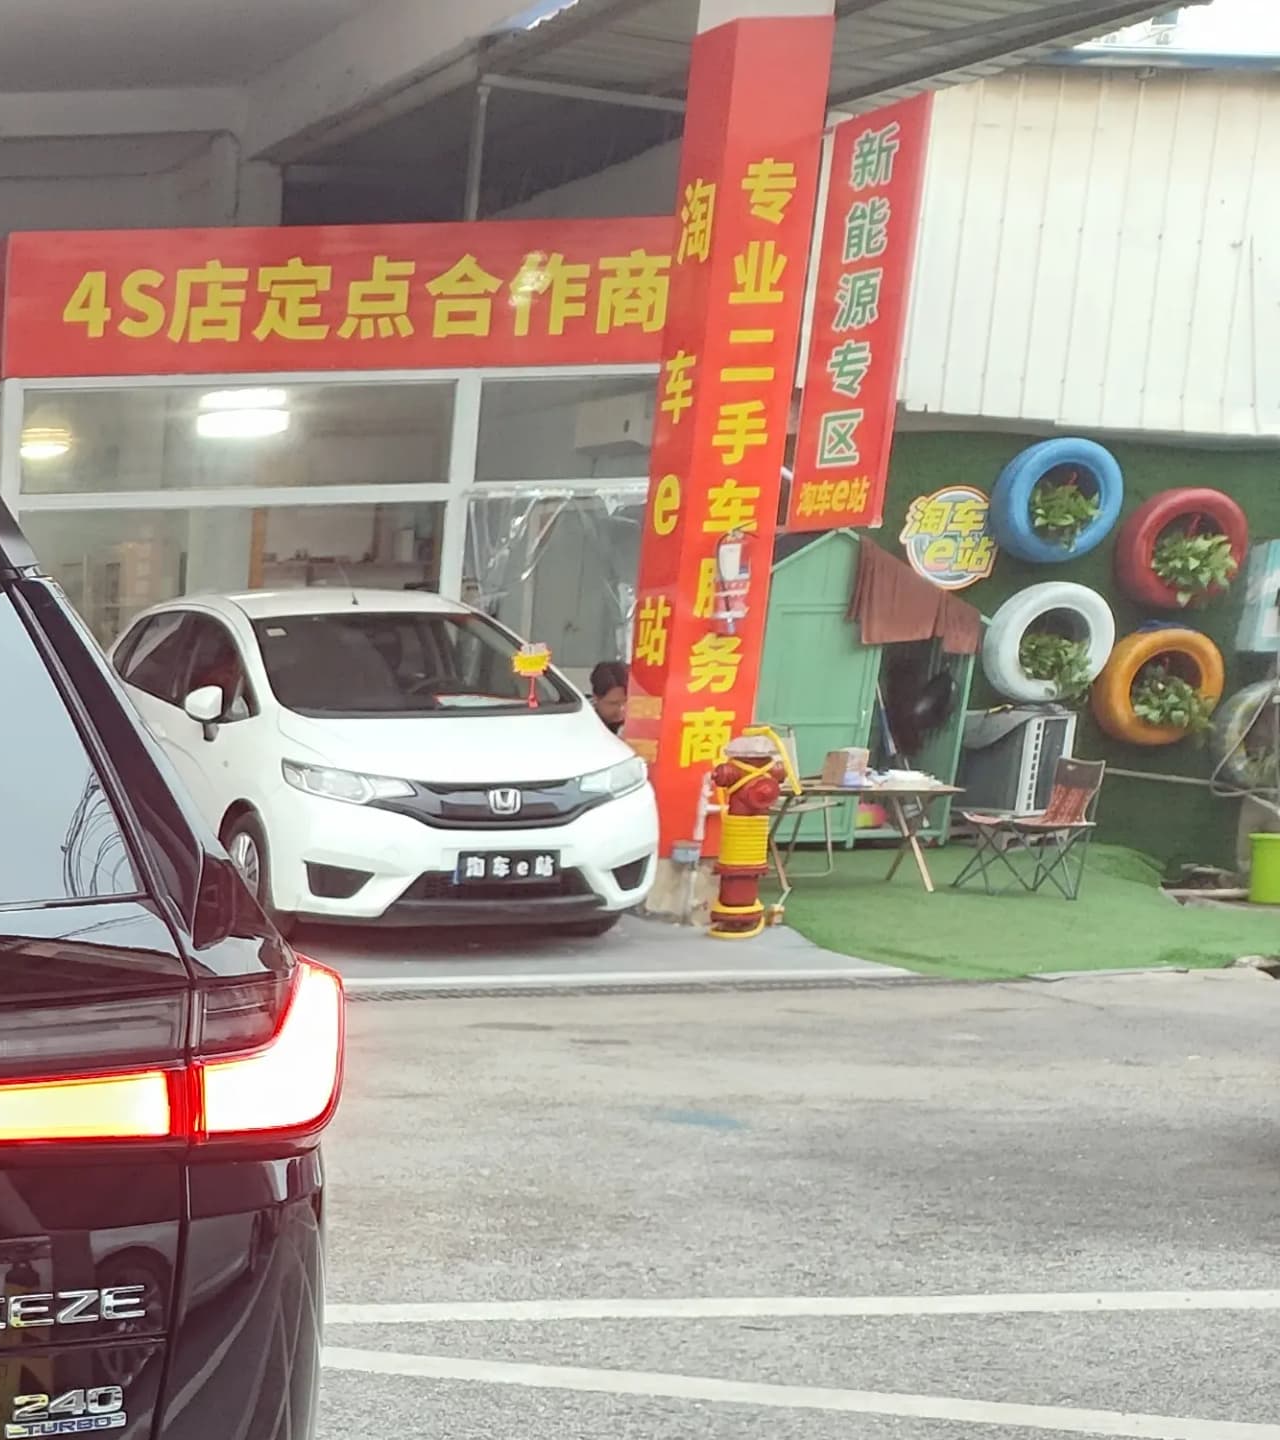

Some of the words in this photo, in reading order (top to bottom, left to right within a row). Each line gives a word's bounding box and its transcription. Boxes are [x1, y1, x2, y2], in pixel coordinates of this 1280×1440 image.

[62, 249, 672, 345] 4S店定点合作商
[814, 121, 900, 470] 新能源专区
[635, 177, 717, 668] 淘车e站
[796, 475, 871, 518] 淘车e站
[906, 499, 990, 537] 淘车
[922, 535, 996, 573] e站
[12, 1385, 125, 1422] 240
[22, 1414, 114, 1437] TURBO
